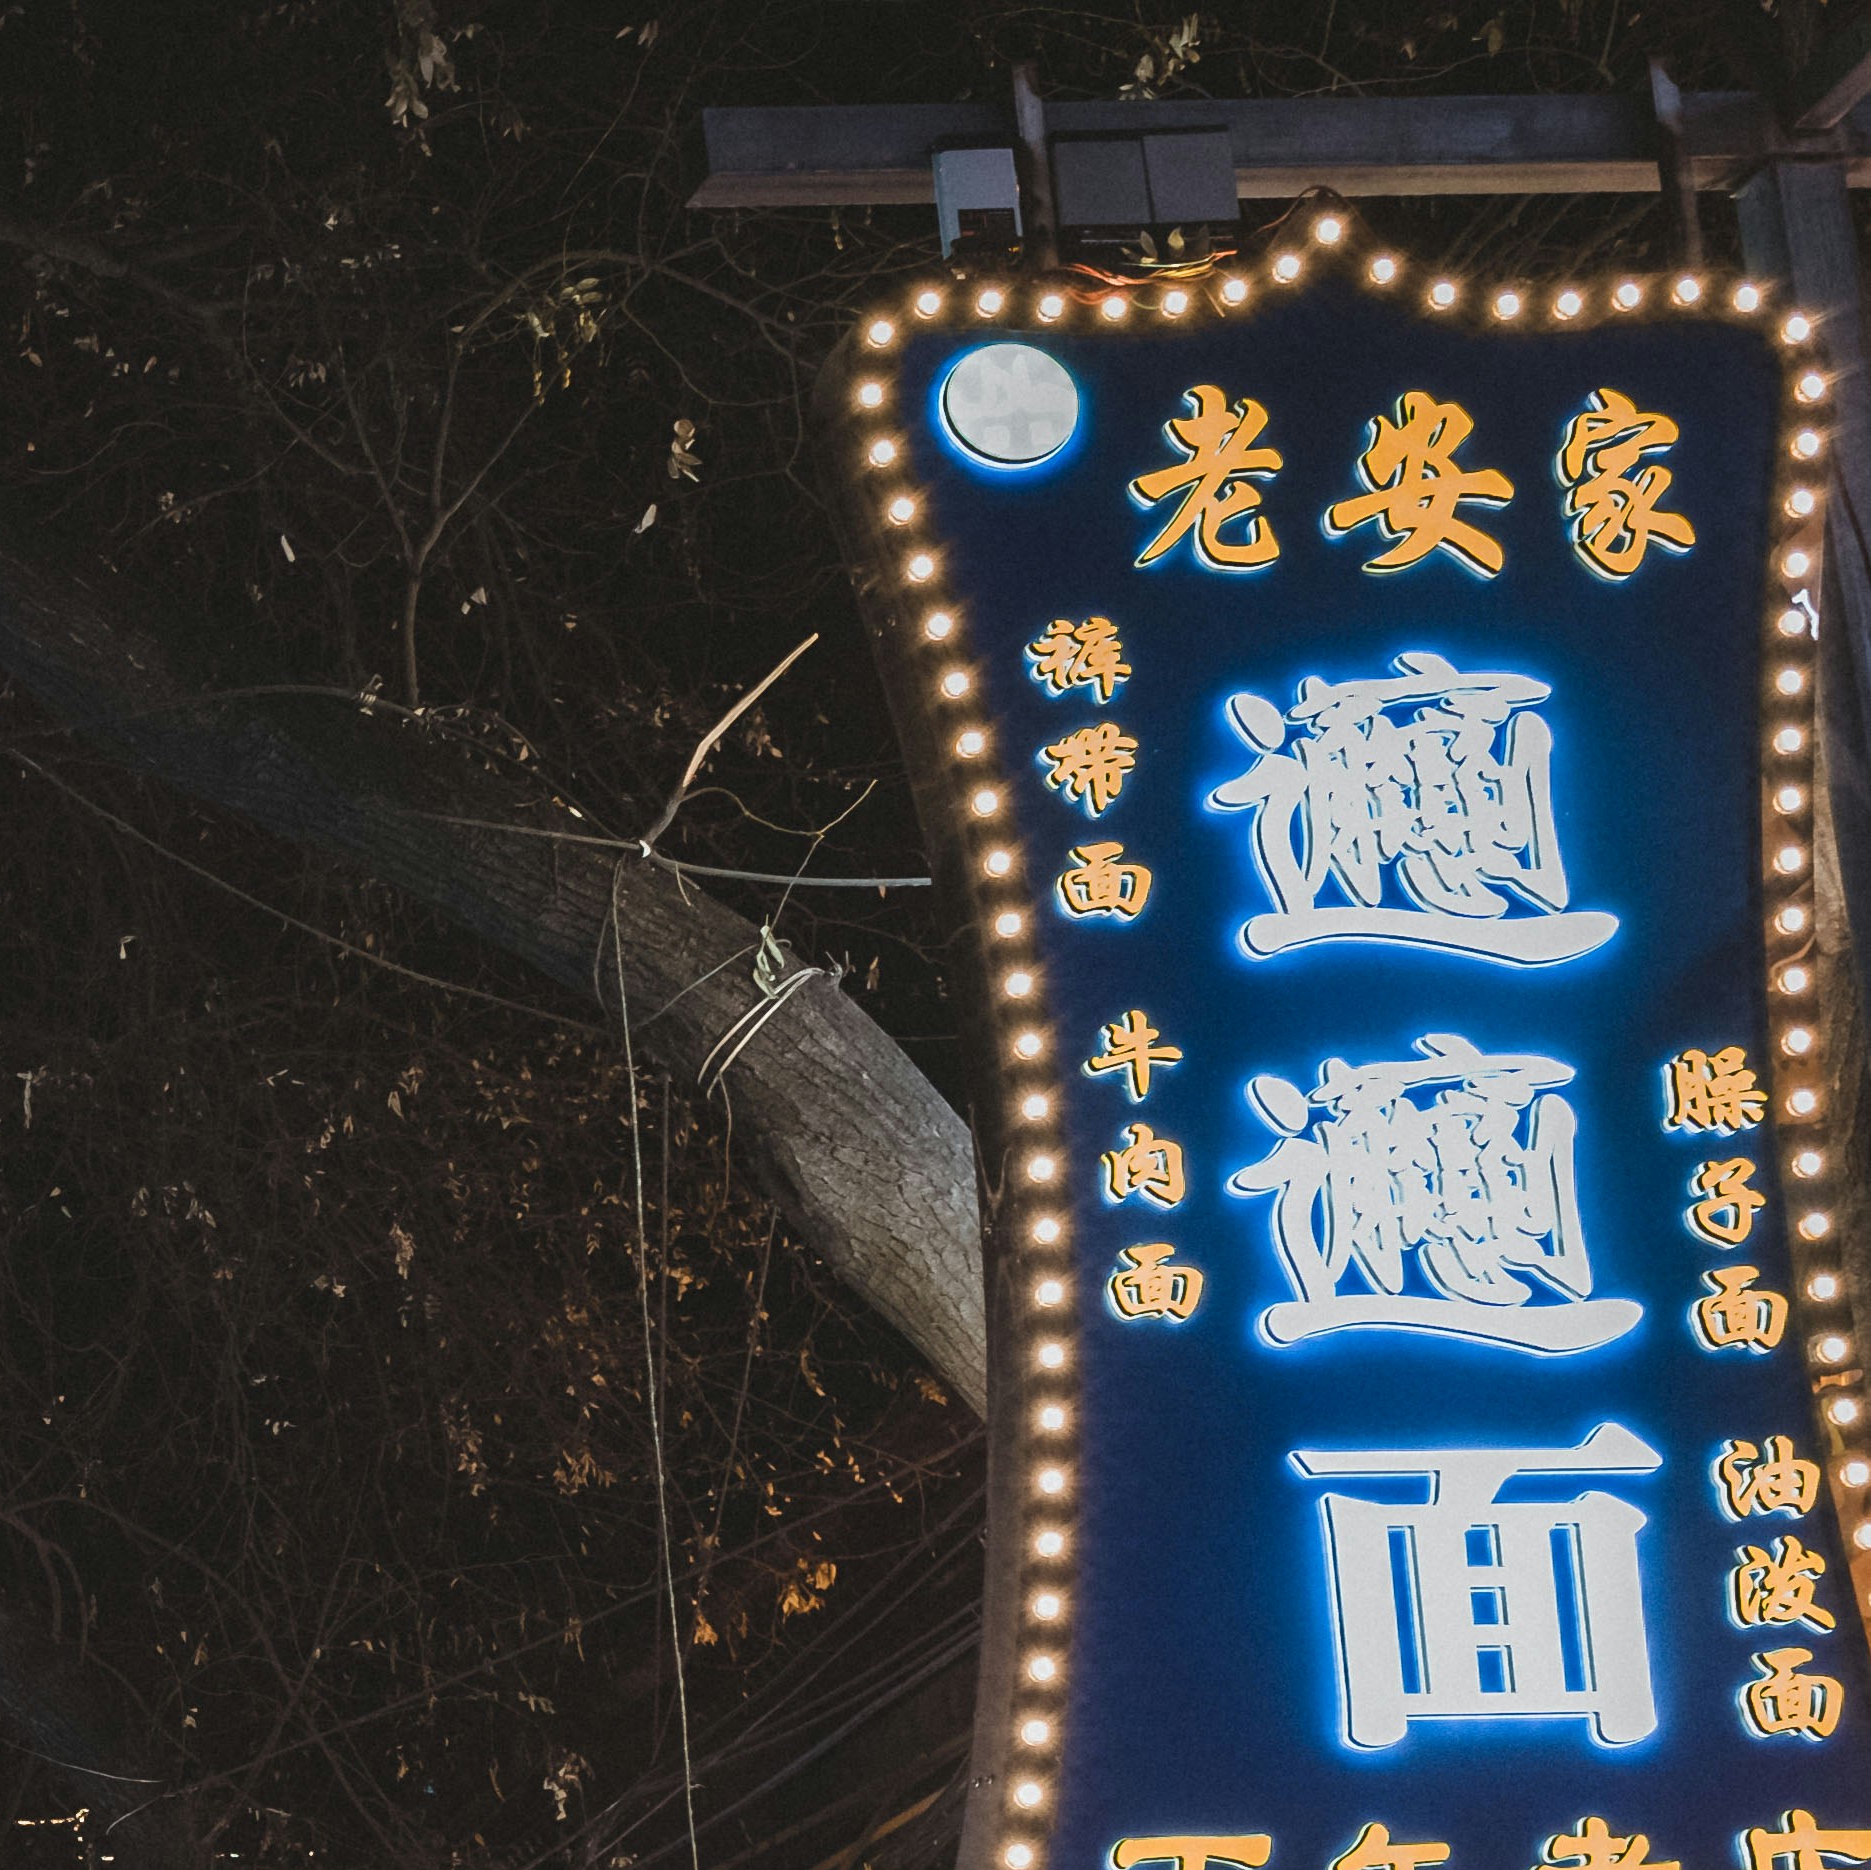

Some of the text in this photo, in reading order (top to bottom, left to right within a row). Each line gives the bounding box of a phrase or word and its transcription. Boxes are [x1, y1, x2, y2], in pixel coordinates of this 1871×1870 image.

[1129, 385, 1696, 580] 老安家
[1083, 1008, 1206, 1324] 牛肉面
[1661, 1044, 1790, 1355] 臊子面
[1712, 1434, 1846, 1744] 油泼面
